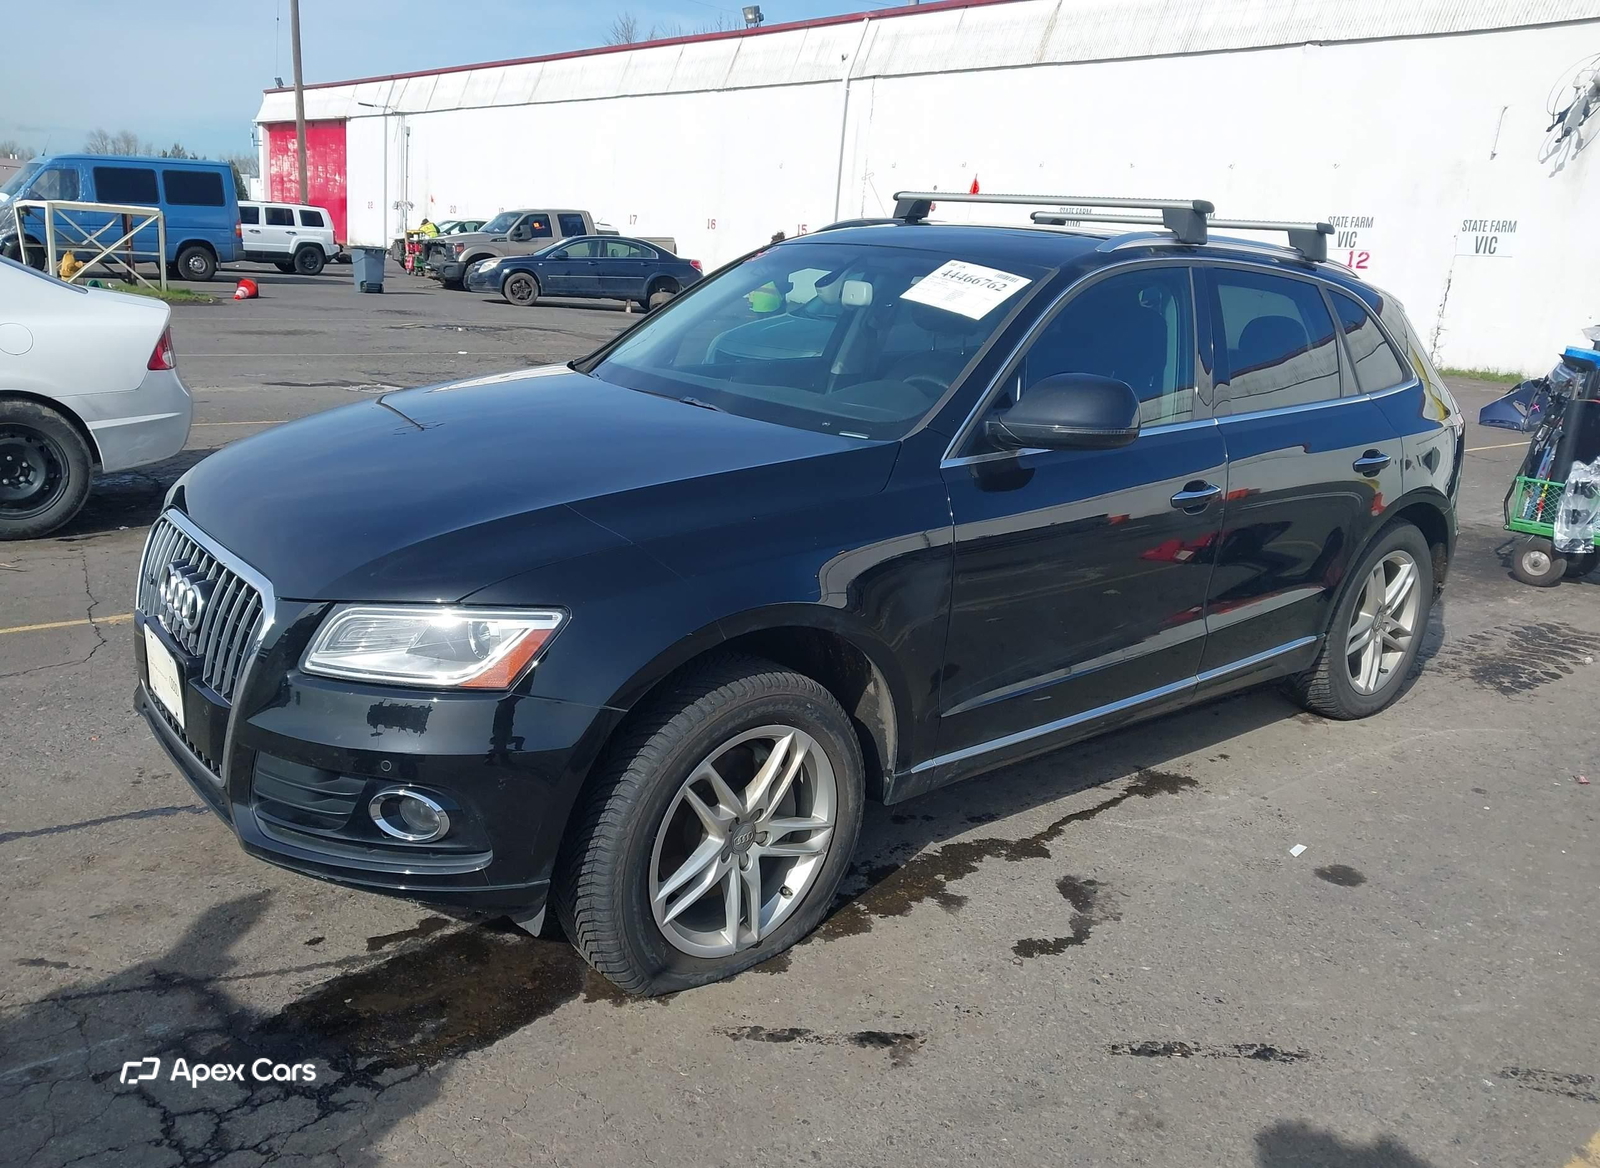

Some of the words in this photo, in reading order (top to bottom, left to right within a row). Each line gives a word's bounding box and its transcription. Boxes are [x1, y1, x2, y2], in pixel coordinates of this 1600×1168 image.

[449, 205, 457, 214] 20
[629, 214, 638, 225] 17
[707, 218, 716, 230] 16
[1328, 216, 1349, 228] STATE
[1350, 216, 1374, 228] FARM
[1461, 219, 1489, 233] STATE
[1489, 219, 1518, 233] FARM
[797, 223, 808, 236] 15
[1337, 230, 1358, 248] VIC
[1474, 235, 1498, 255] VIC
[1347, 250, 1370, 269] 12
[941, 269, 1008, 292] 44466762
